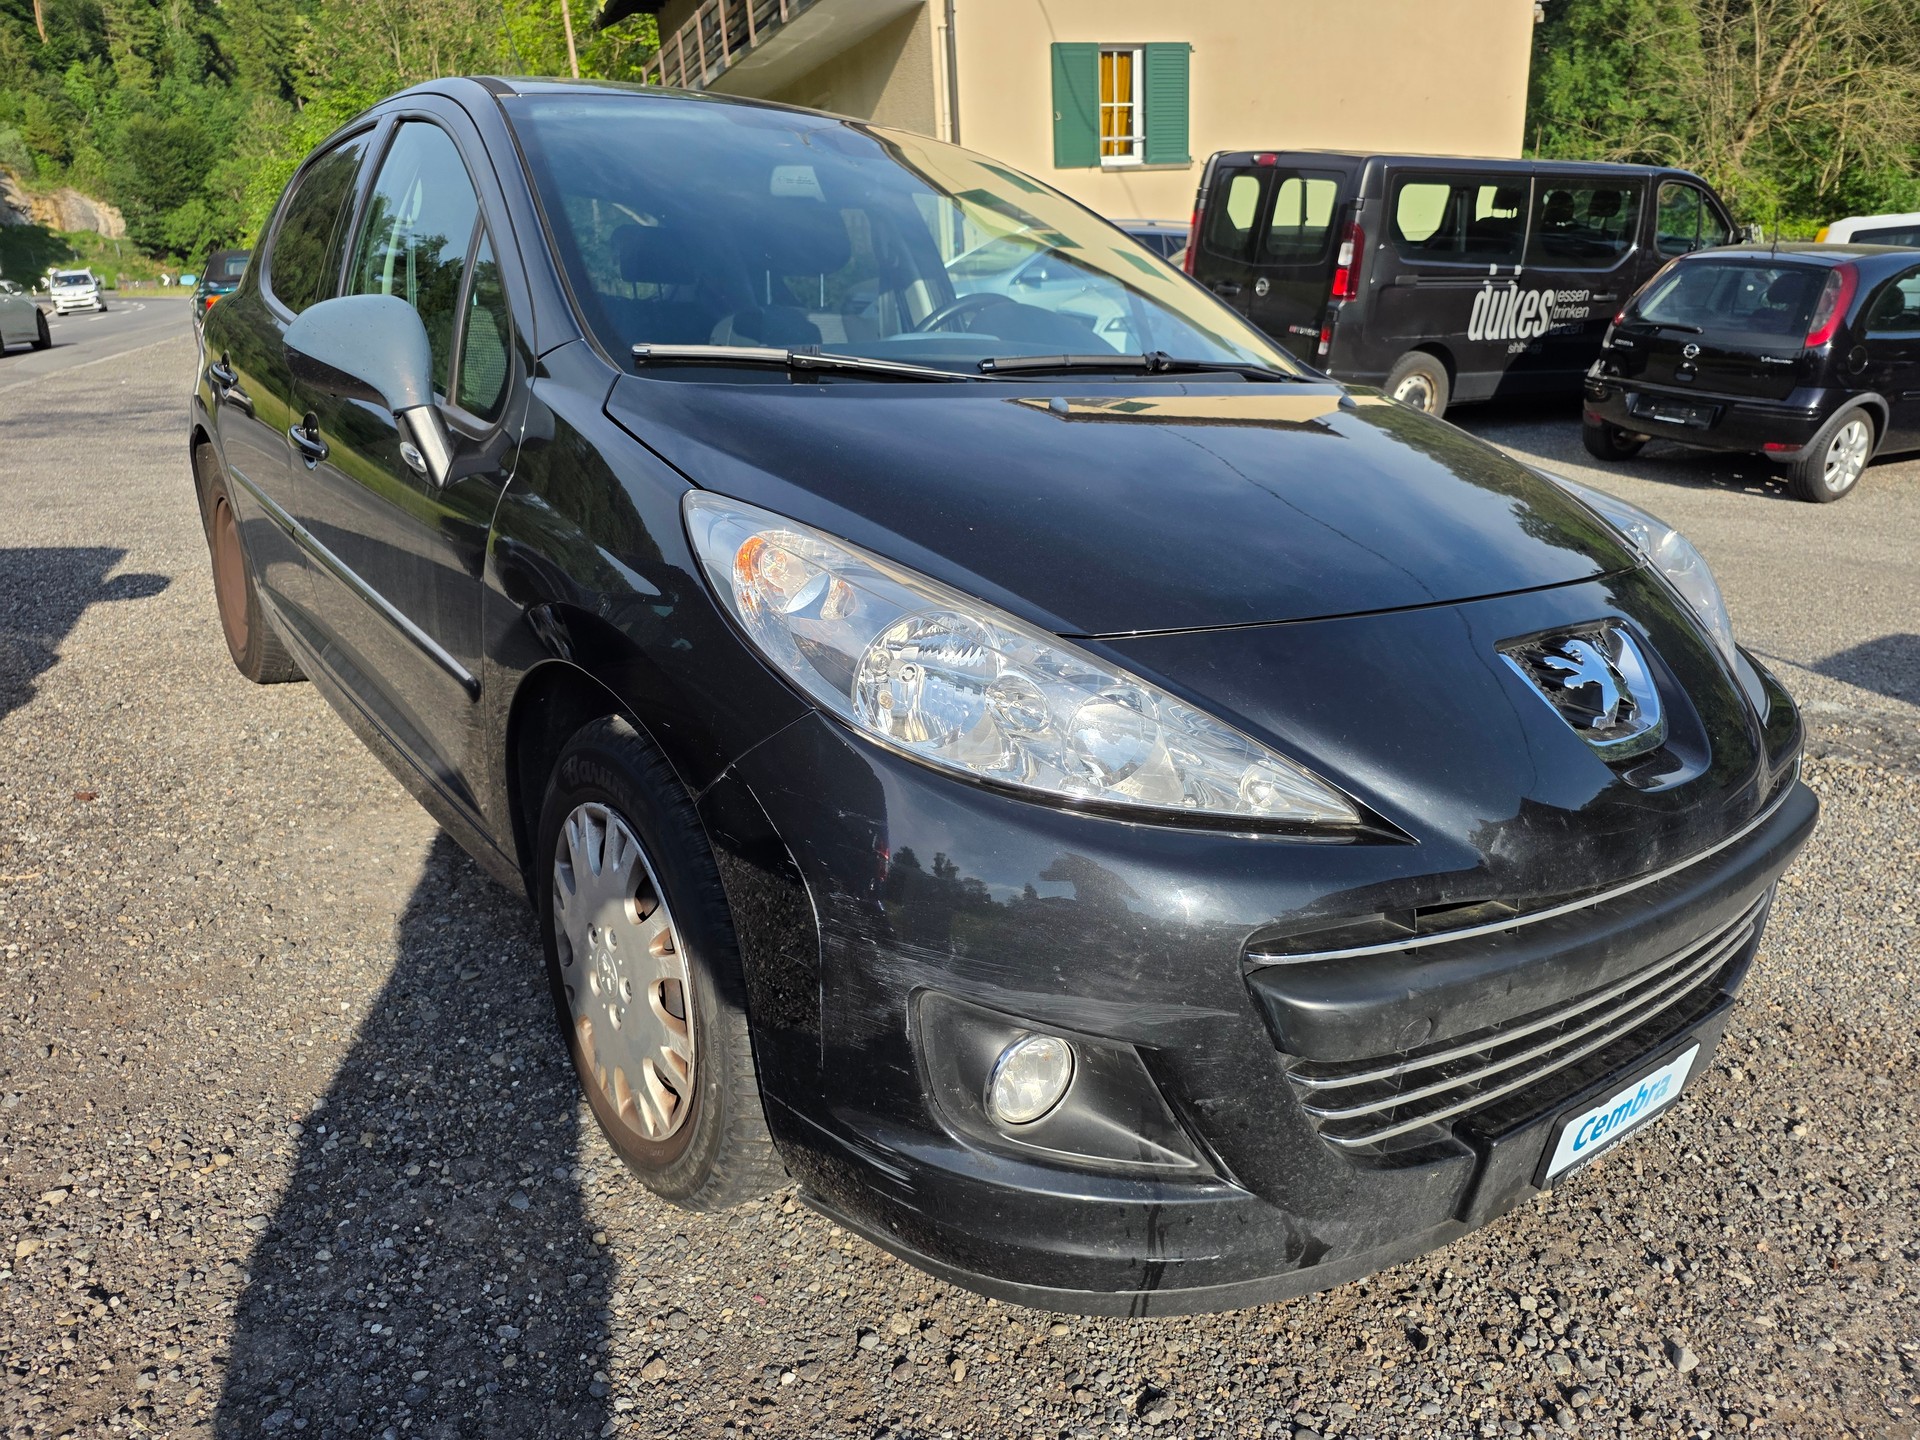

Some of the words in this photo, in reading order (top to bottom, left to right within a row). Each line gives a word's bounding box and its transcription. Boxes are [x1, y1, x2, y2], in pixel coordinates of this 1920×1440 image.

[1557, 289, 1590, 302] essen
[1553, 305, 1590, 320] trinken
[1572, 1072, 1672, 1152] Cembra
